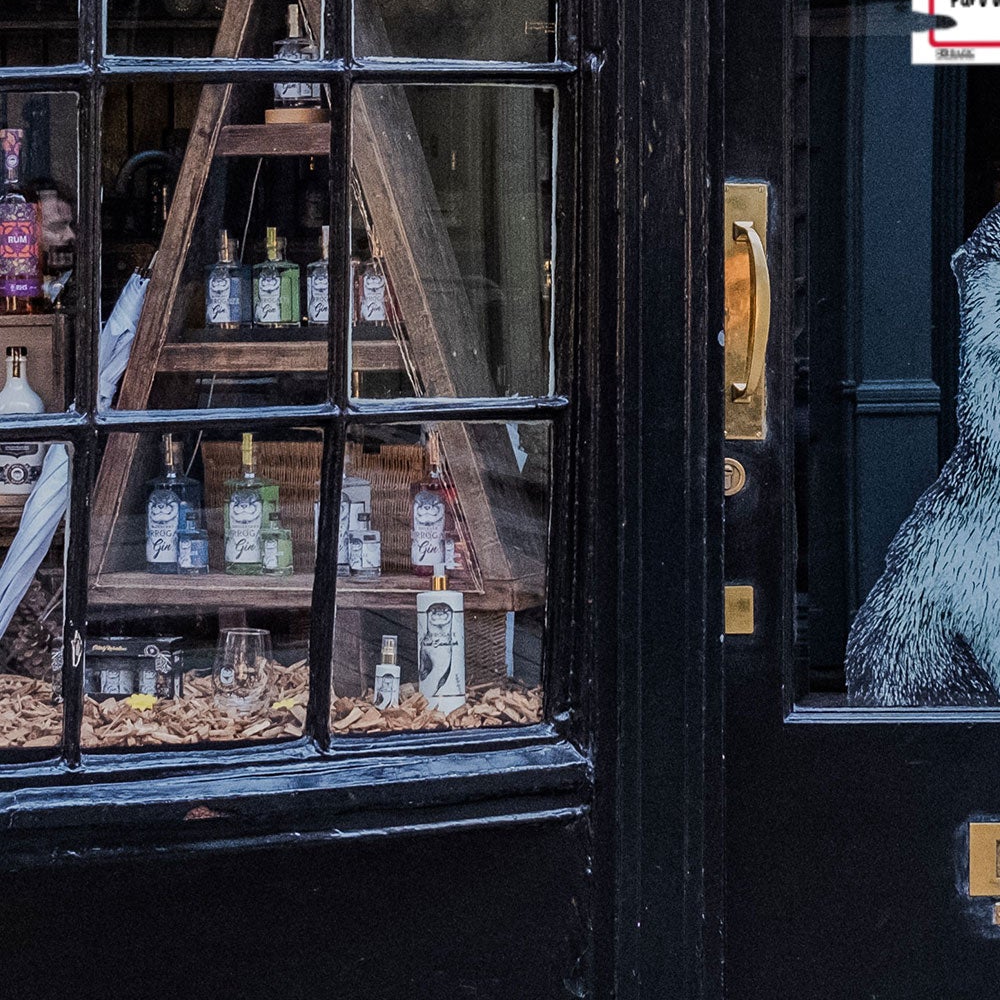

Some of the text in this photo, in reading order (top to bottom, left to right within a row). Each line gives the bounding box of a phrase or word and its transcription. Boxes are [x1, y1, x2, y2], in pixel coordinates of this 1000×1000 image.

[7, 235, 28, 244] RUM
[152, 538, 172, 559] Gin
[235, 538, 256, 559] Gin
[418, 540, 439, 561] Gin
